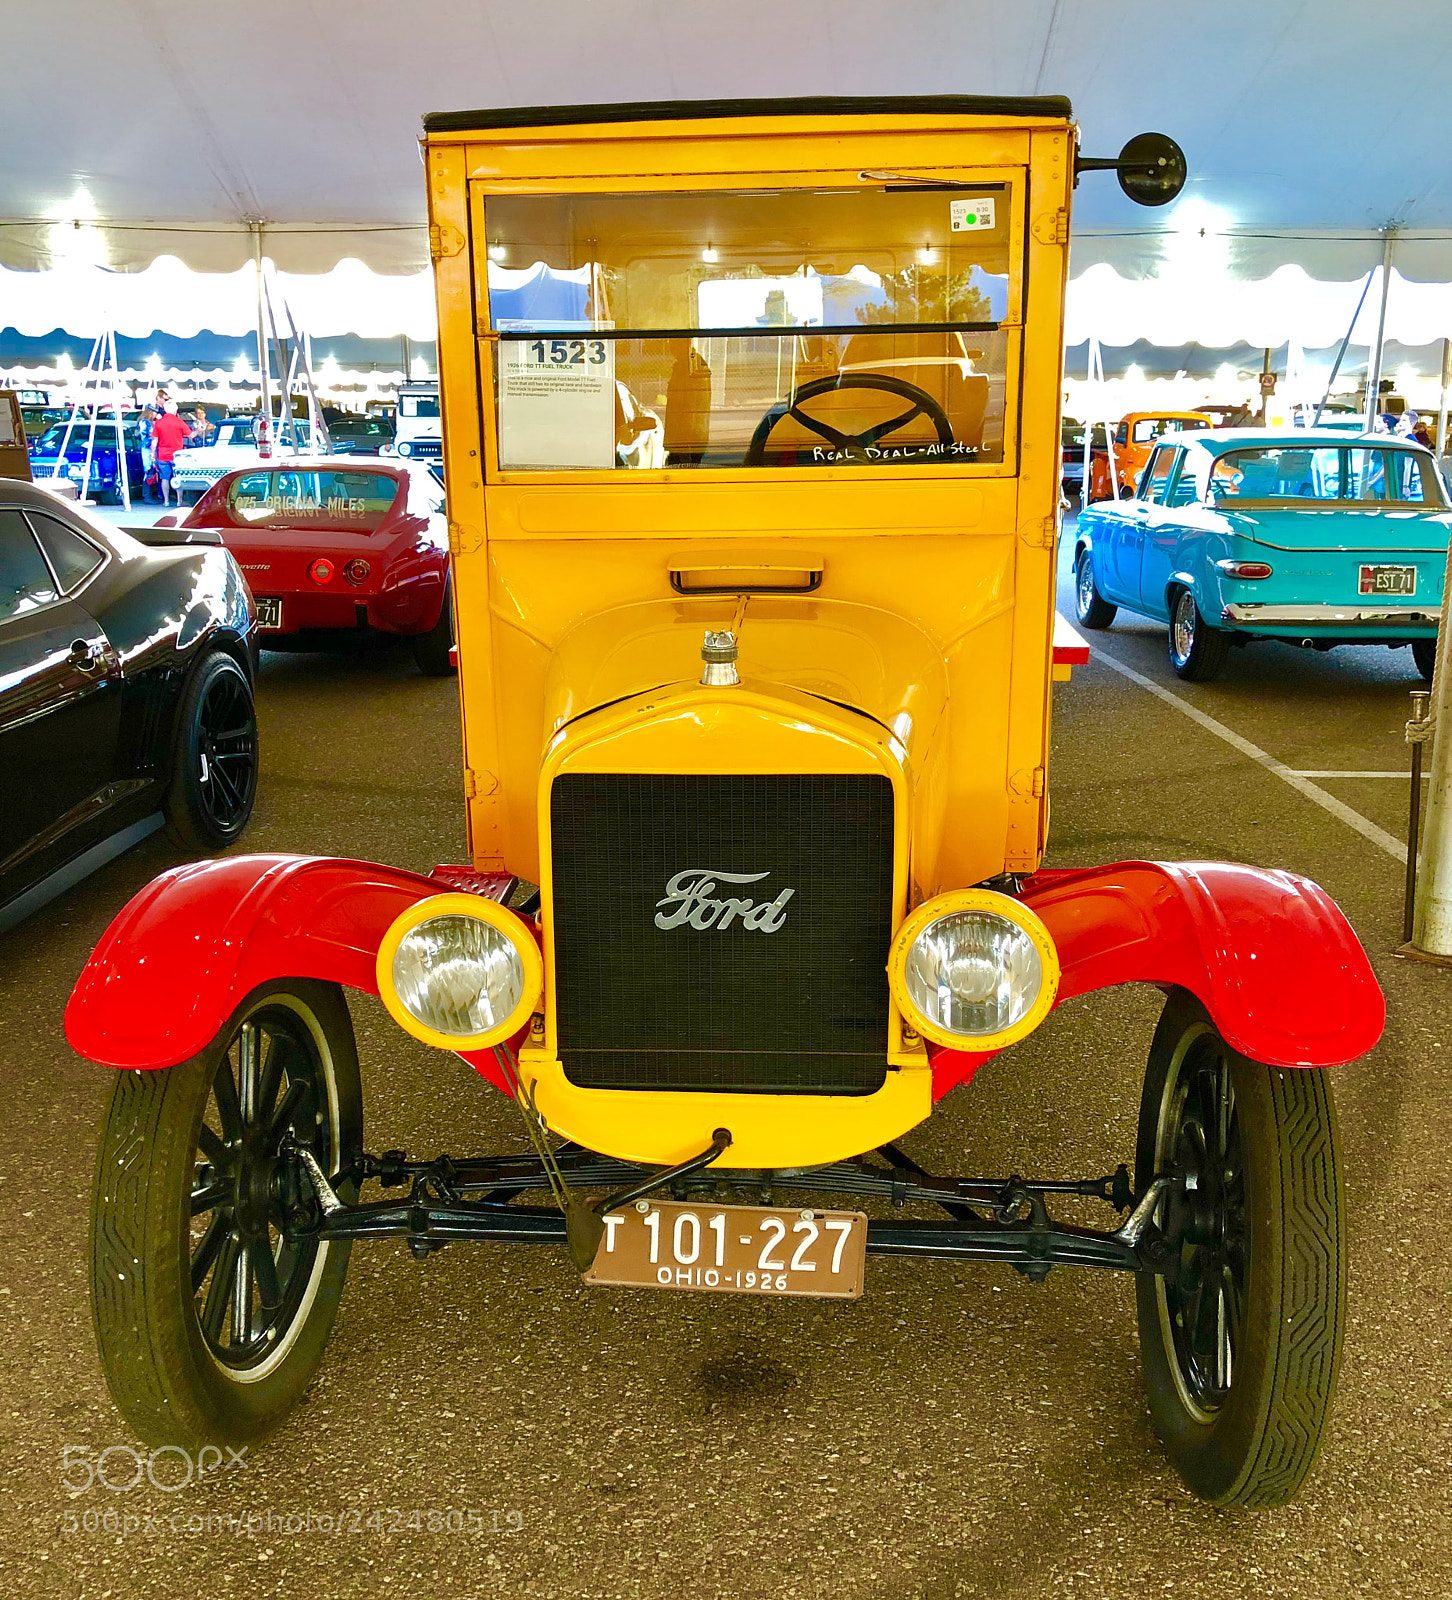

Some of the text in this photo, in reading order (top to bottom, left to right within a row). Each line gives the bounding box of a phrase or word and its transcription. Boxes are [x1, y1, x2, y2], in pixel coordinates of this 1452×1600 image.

[531, 341, 606, 364] 1523
[265, 495, 322, 510] ORIGINAL
[327, 496, 366, 512] MILES
[1376, 573, 1411, 589] EST 71
[264, 606, 276, 621] 71
[654, 869, 796, 934] Ford
[643, 1211, 853, 1275] 101-227
[656, 1266, 788, 1291] OHIO-1926
